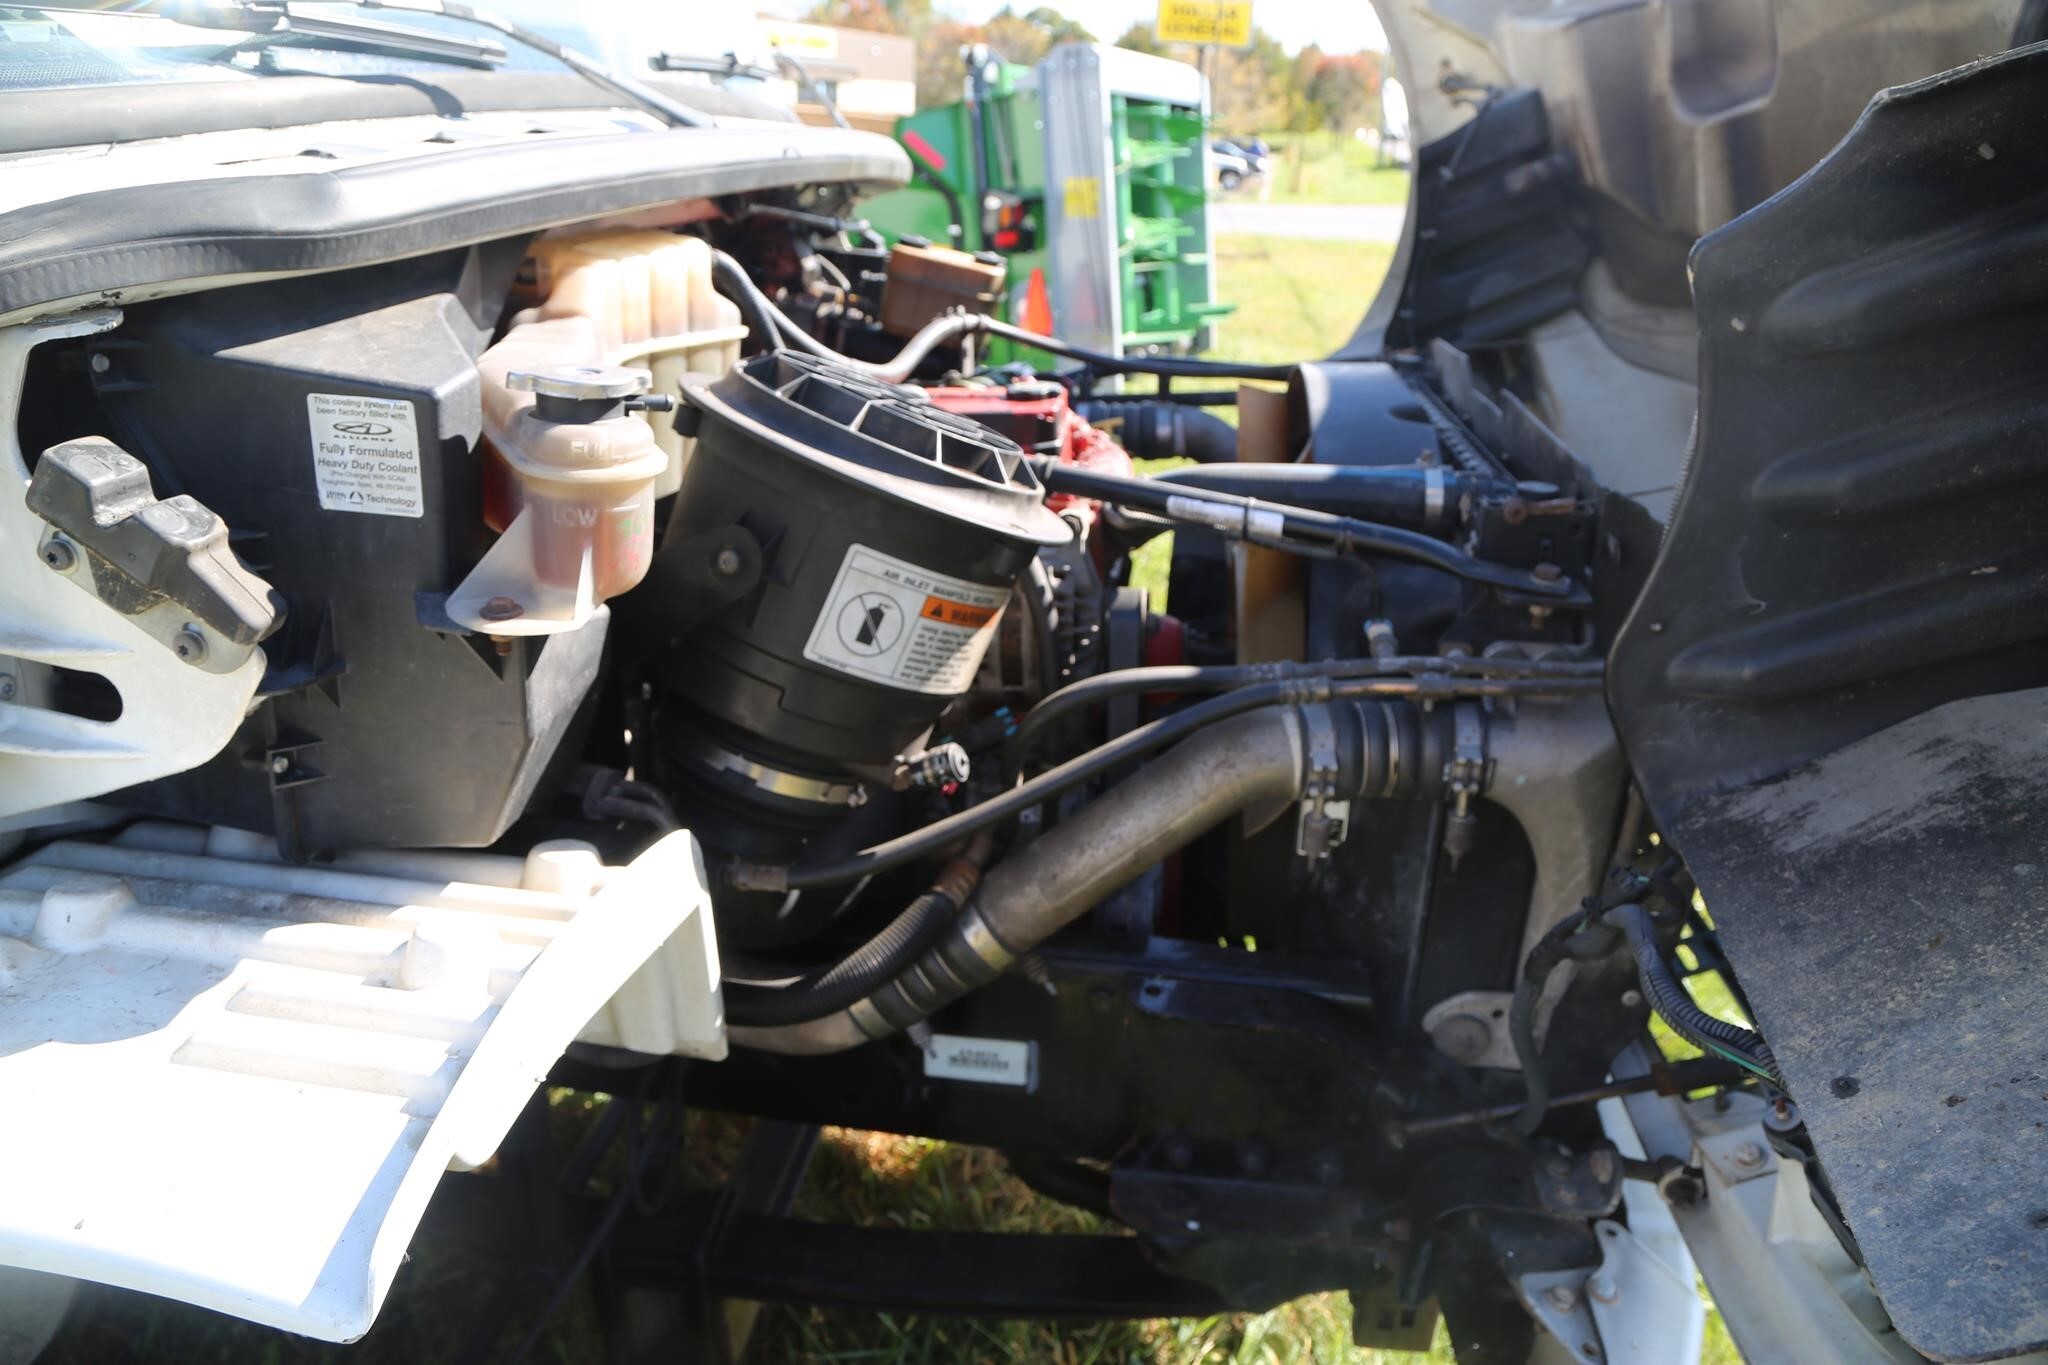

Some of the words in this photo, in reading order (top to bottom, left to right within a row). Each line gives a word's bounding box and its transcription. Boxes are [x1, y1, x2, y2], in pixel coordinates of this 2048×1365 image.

[313, 396, 330, 406] This
[332, 398, 361, 408] cooling
[364, 401, 390, 410] system
[393, 401, 408, 410] has
[316, 407, 336, 415] been
[338, 409, 366, 418] factory
[369, 411, 388, 419] filled
[390, 412, 407, 420] with
[319, 443, 346, 456] Fully
[349, 445, 413, 459] Formulated
[318, 458, 349, 470] Heavy
[351, 460, 375, 472] Duty
[378, 463, 418, 474] Coolant
[326, 490, 346, 500] With
[366, 494, 417, 508] Technology
[553, 507, 598, 526] LOW
[884, 570, 900, 583] AIR
[904, 577, 930, 592] INLET
